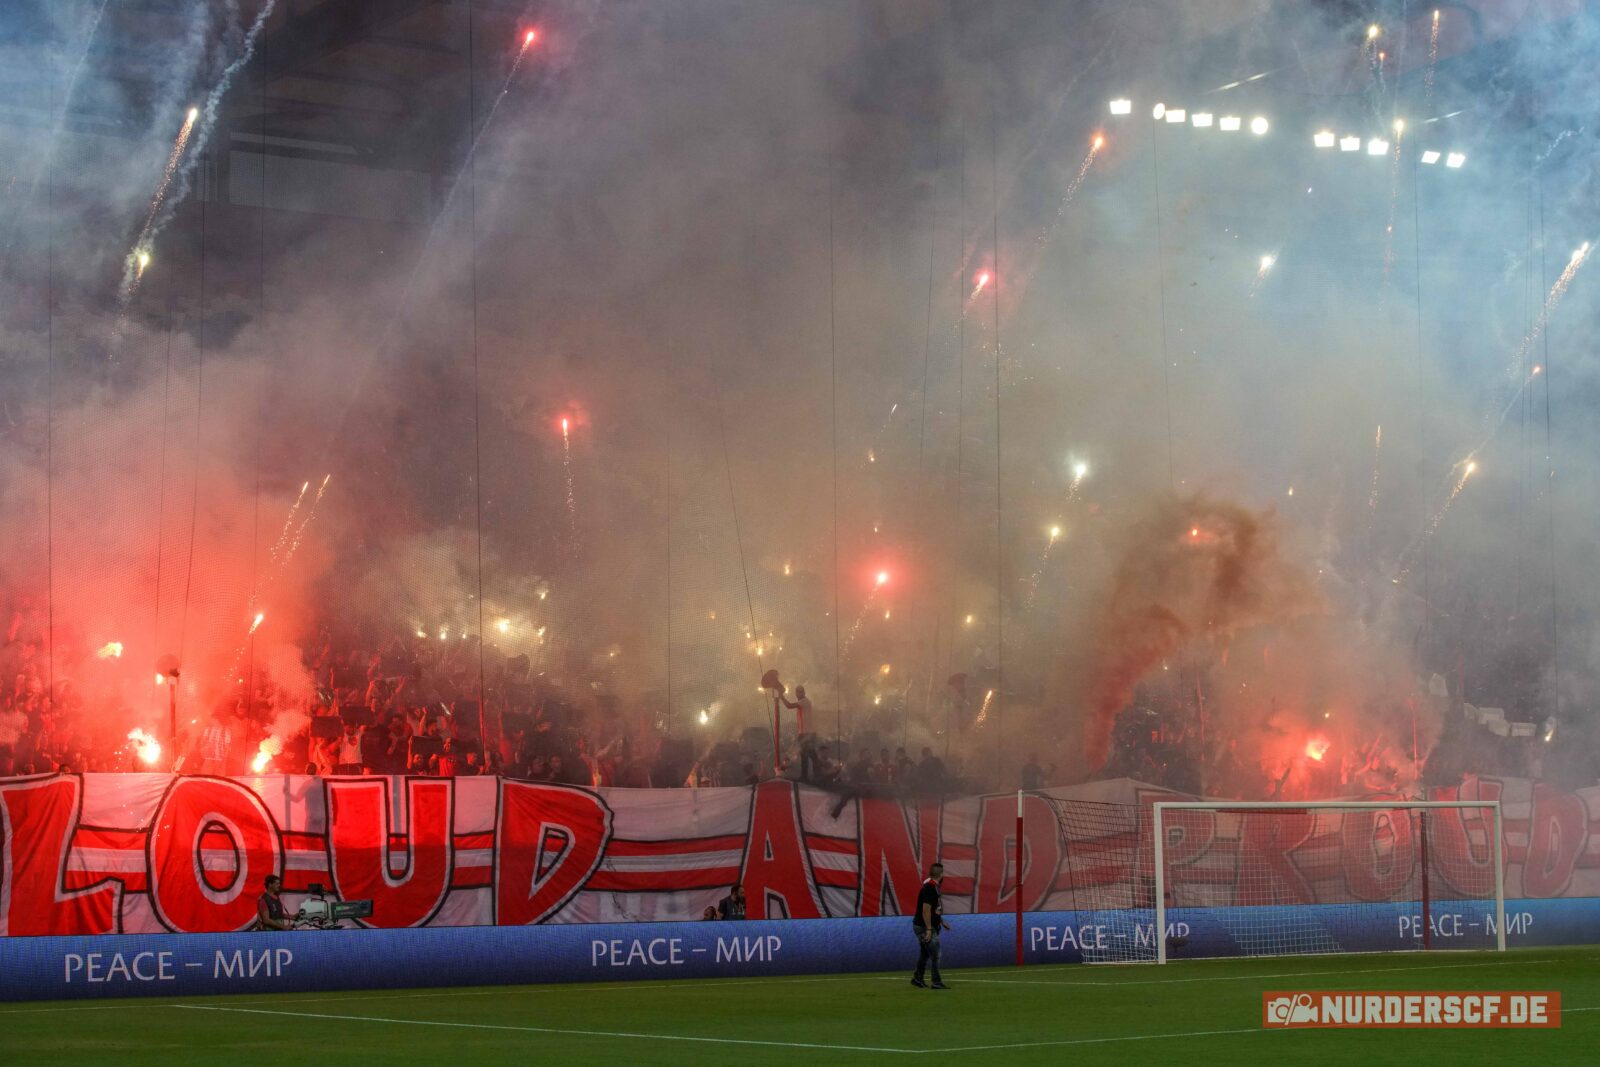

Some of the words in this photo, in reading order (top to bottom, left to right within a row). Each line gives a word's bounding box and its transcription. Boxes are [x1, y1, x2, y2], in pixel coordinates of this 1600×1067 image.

[0, 773, 614, 936] LOUD
[737, 778, 1065, 919] AND
[1133, 776, 1590, 912] PROUD
[1030, 925, 1108, 951] PEACE
[1398, 914, 1464, 938] PEACE
[64, 951, 175, 983] PEACE
[213, 948, 293, 979] МИР
[591, 938, 685, 967] PEACE
[715, 935, 782, 963] МИР
